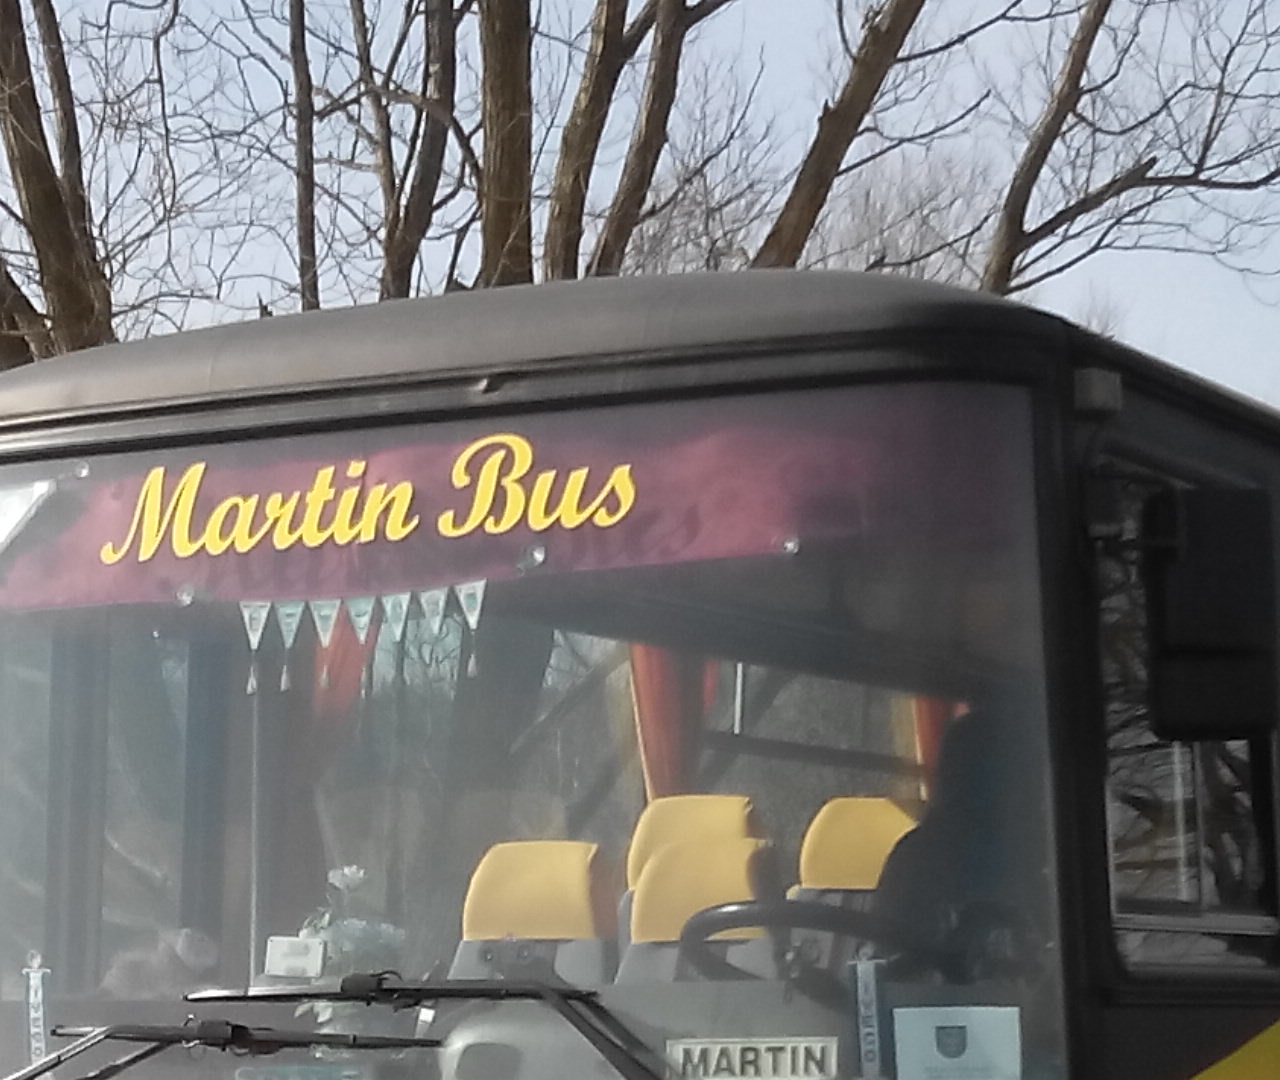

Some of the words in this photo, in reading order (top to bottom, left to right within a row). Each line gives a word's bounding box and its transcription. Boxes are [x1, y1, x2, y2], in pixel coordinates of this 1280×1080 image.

[100, 460, 420, 565] Martin
[438, 433, 637, 538] Bus
[681, 1044, 828, 1078] MARTIN
